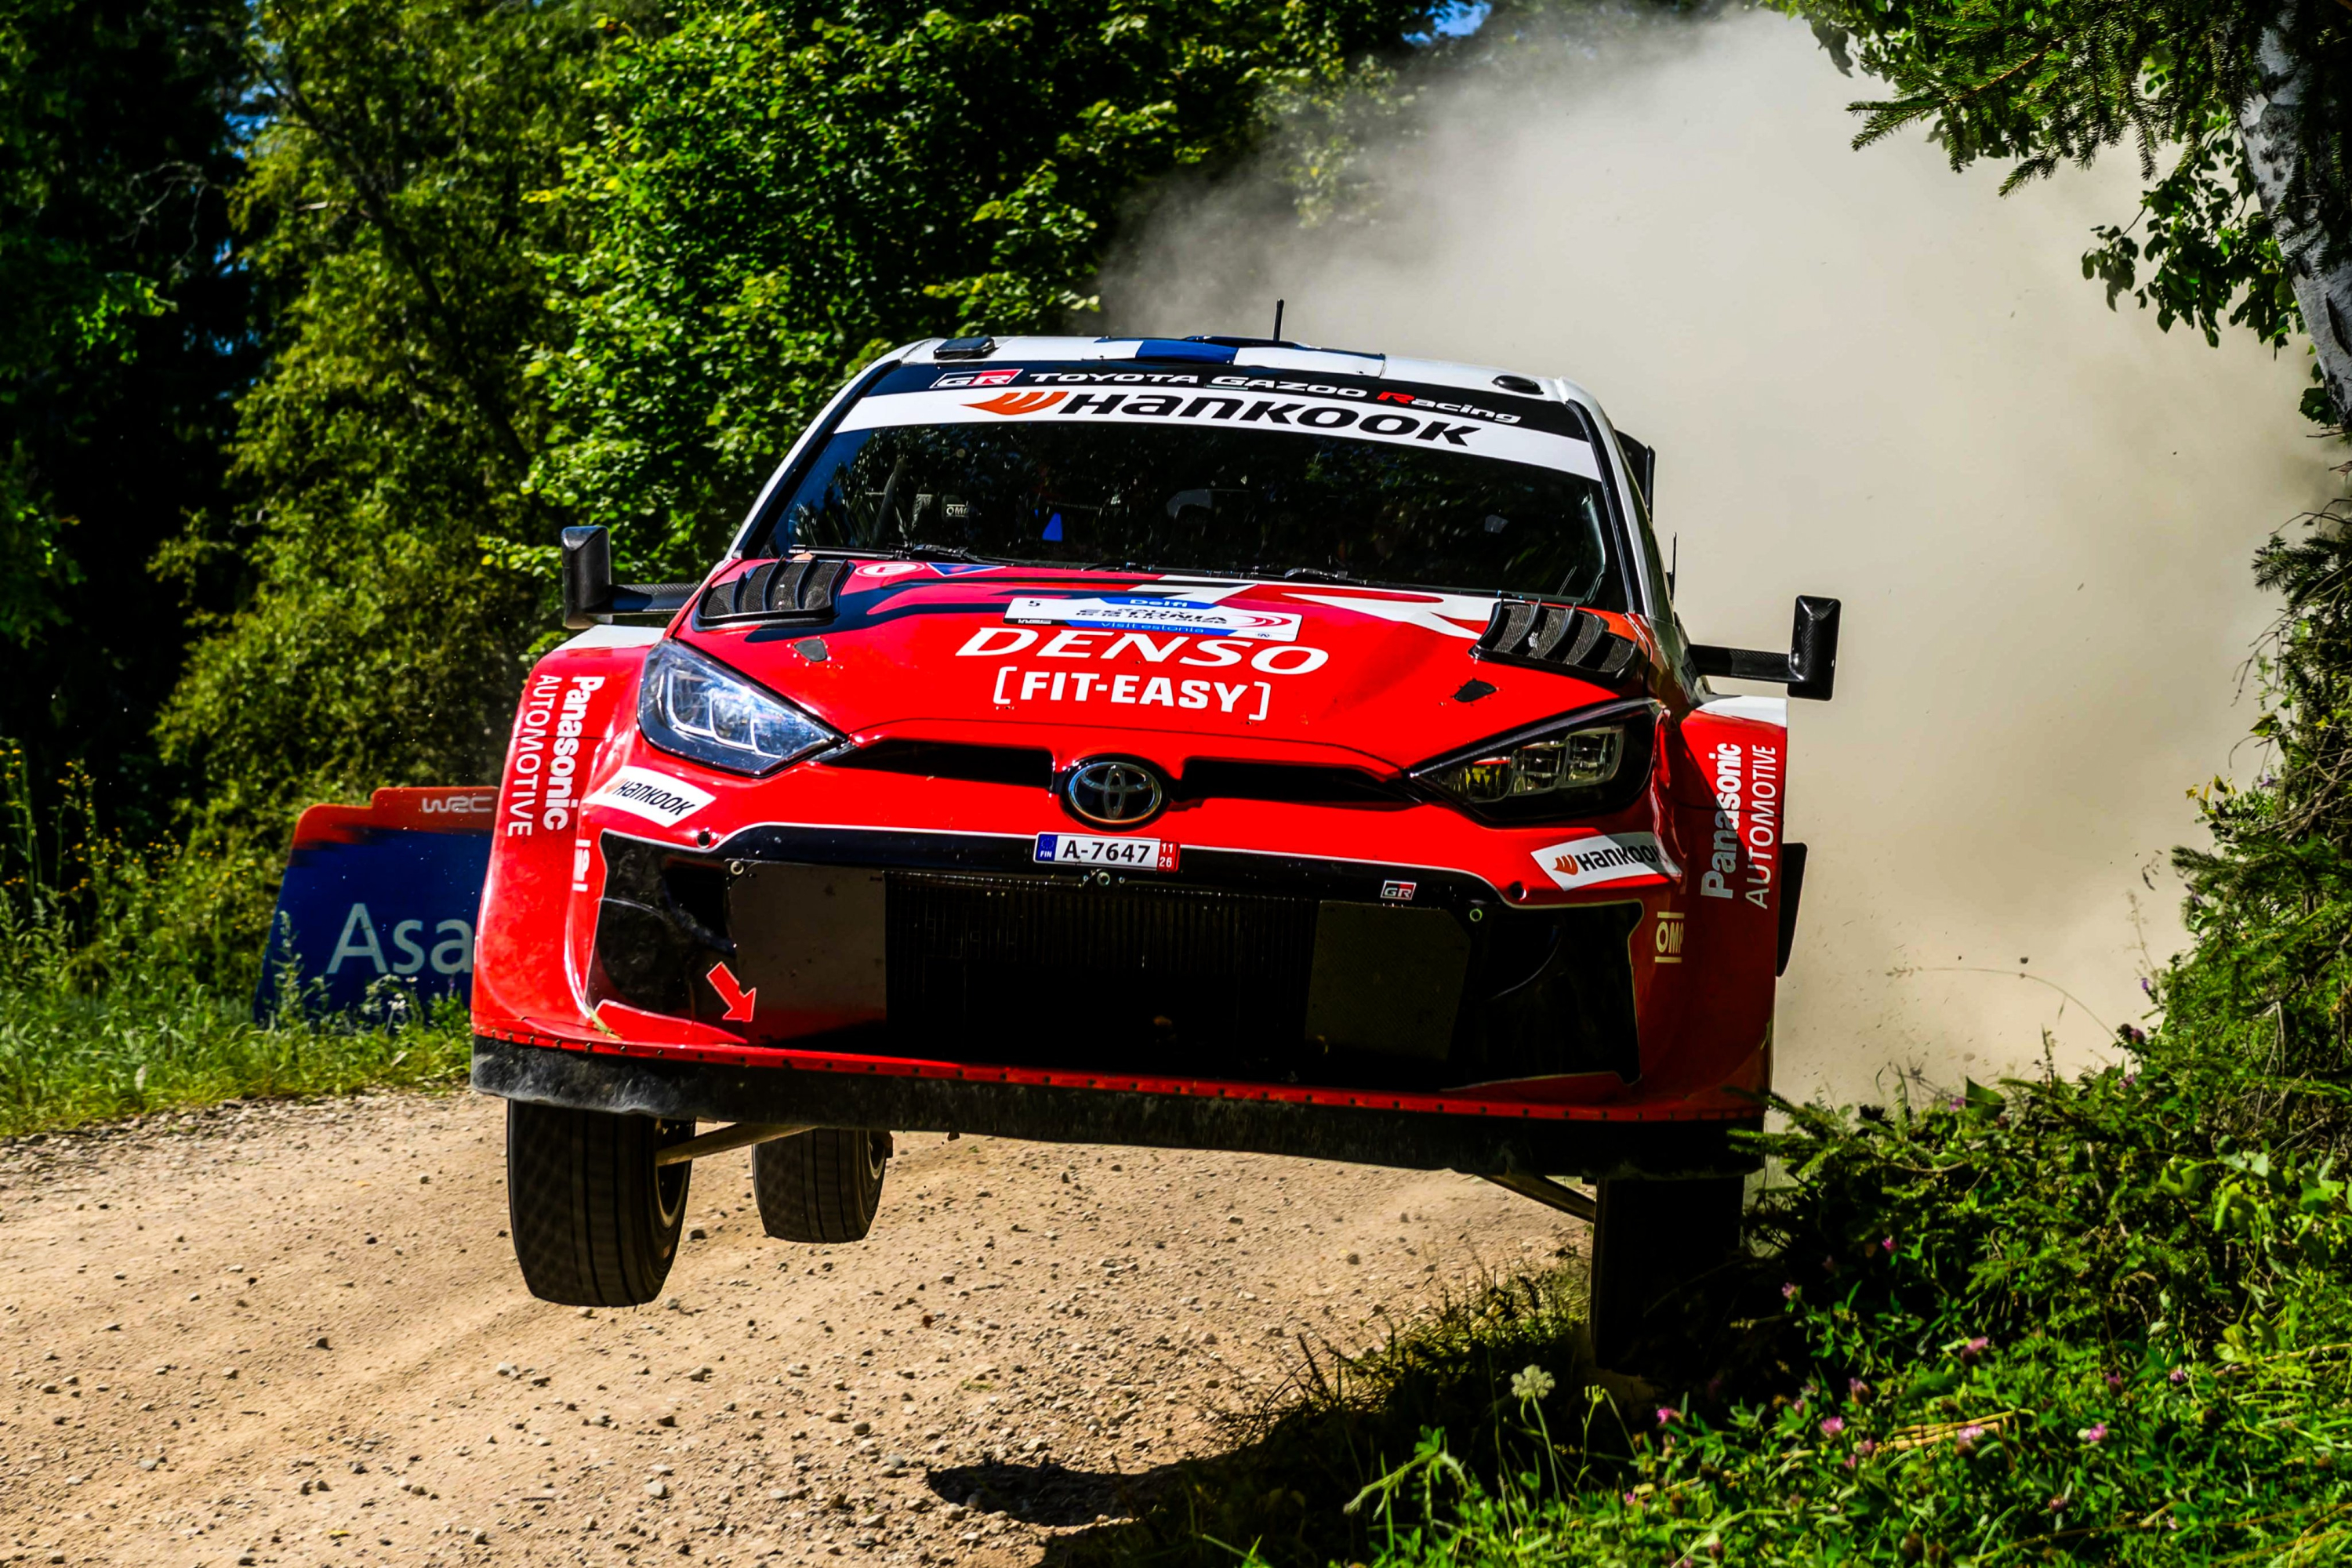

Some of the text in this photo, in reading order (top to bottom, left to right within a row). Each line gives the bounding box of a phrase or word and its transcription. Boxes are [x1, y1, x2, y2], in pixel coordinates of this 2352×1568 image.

[936, 373, 1522, 424] GR TOYOTA GAZOO Racing
[1141, 625, 1204, 633] estonia
[955, 627, 1329, 675] DENSO
[993, 666, 1272, 721] [FIT-EASY]
[507, 674, 562, 837] AUTOMOTIVE
[543, 676, 605, 831] Panasonic
[422, 796, 493, 813] WRC
[1700, 742, 1742, 899] Panasonic
[1745, 744, 1777, 909] AUTOMOTIVE
[1040, 850, 1053, 858] FIN
[1062, 840, 1151, 864] A-7647
[1159, 857, 1172, 868] 26
[1161, 843, 1174, 854] 11
[1384, 886, 1413, 899] GR
[1656, 921, 1684, 954] OMP
